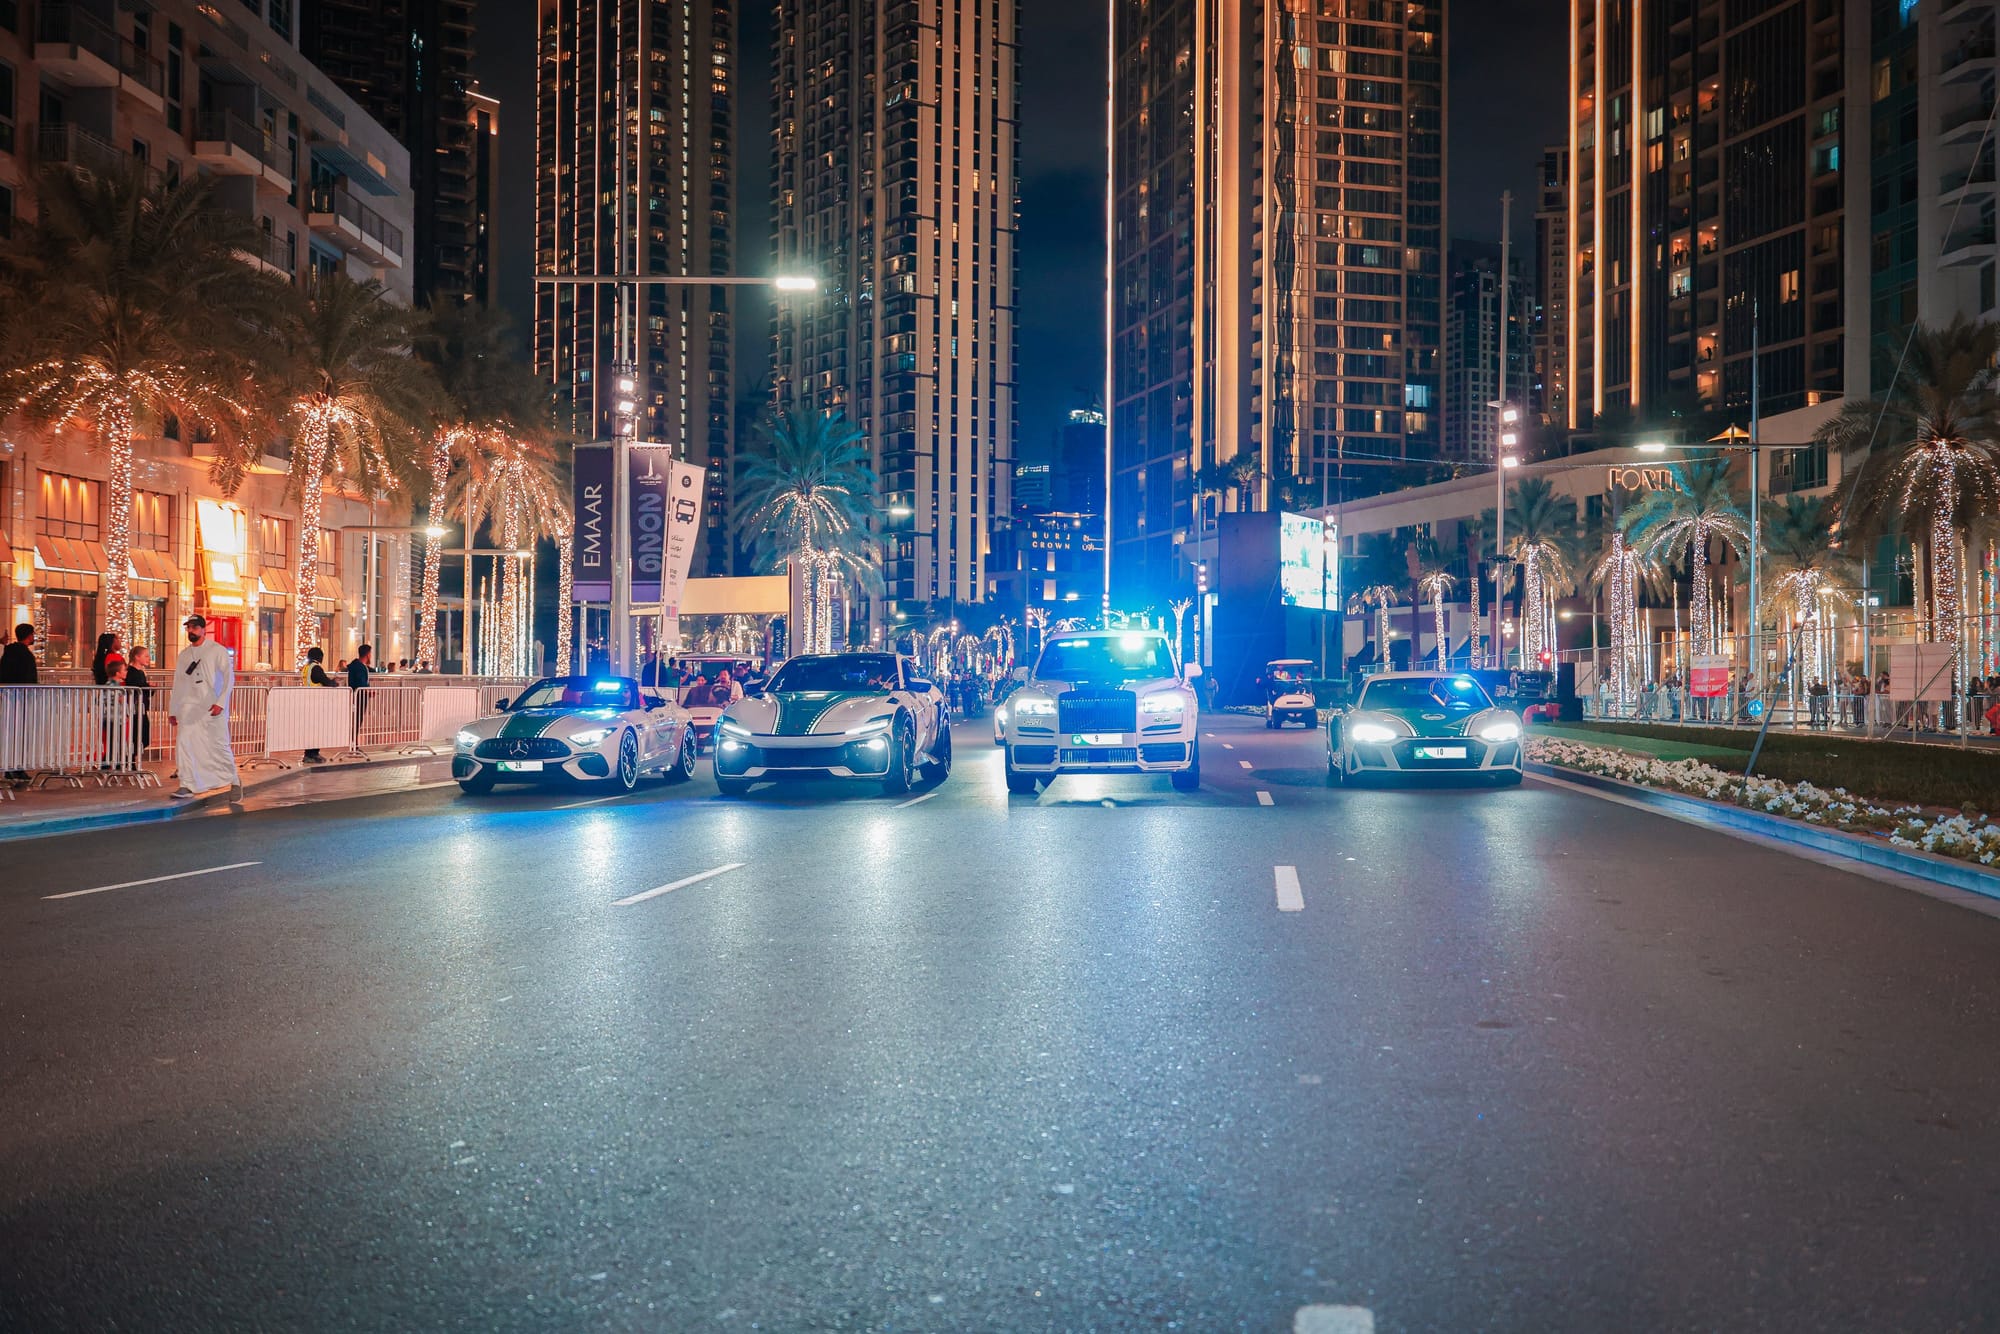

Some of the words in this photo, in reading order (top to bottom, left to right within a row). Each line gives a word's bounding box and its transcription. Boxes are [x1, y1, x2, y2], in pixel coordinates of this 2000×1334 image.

[583, 483, 602, 567] EMAAR
[638, 492, 663, 573] 2026
[1032, 540, 1071, 550] CROWN
[831, 601, 841, 638] 2026
